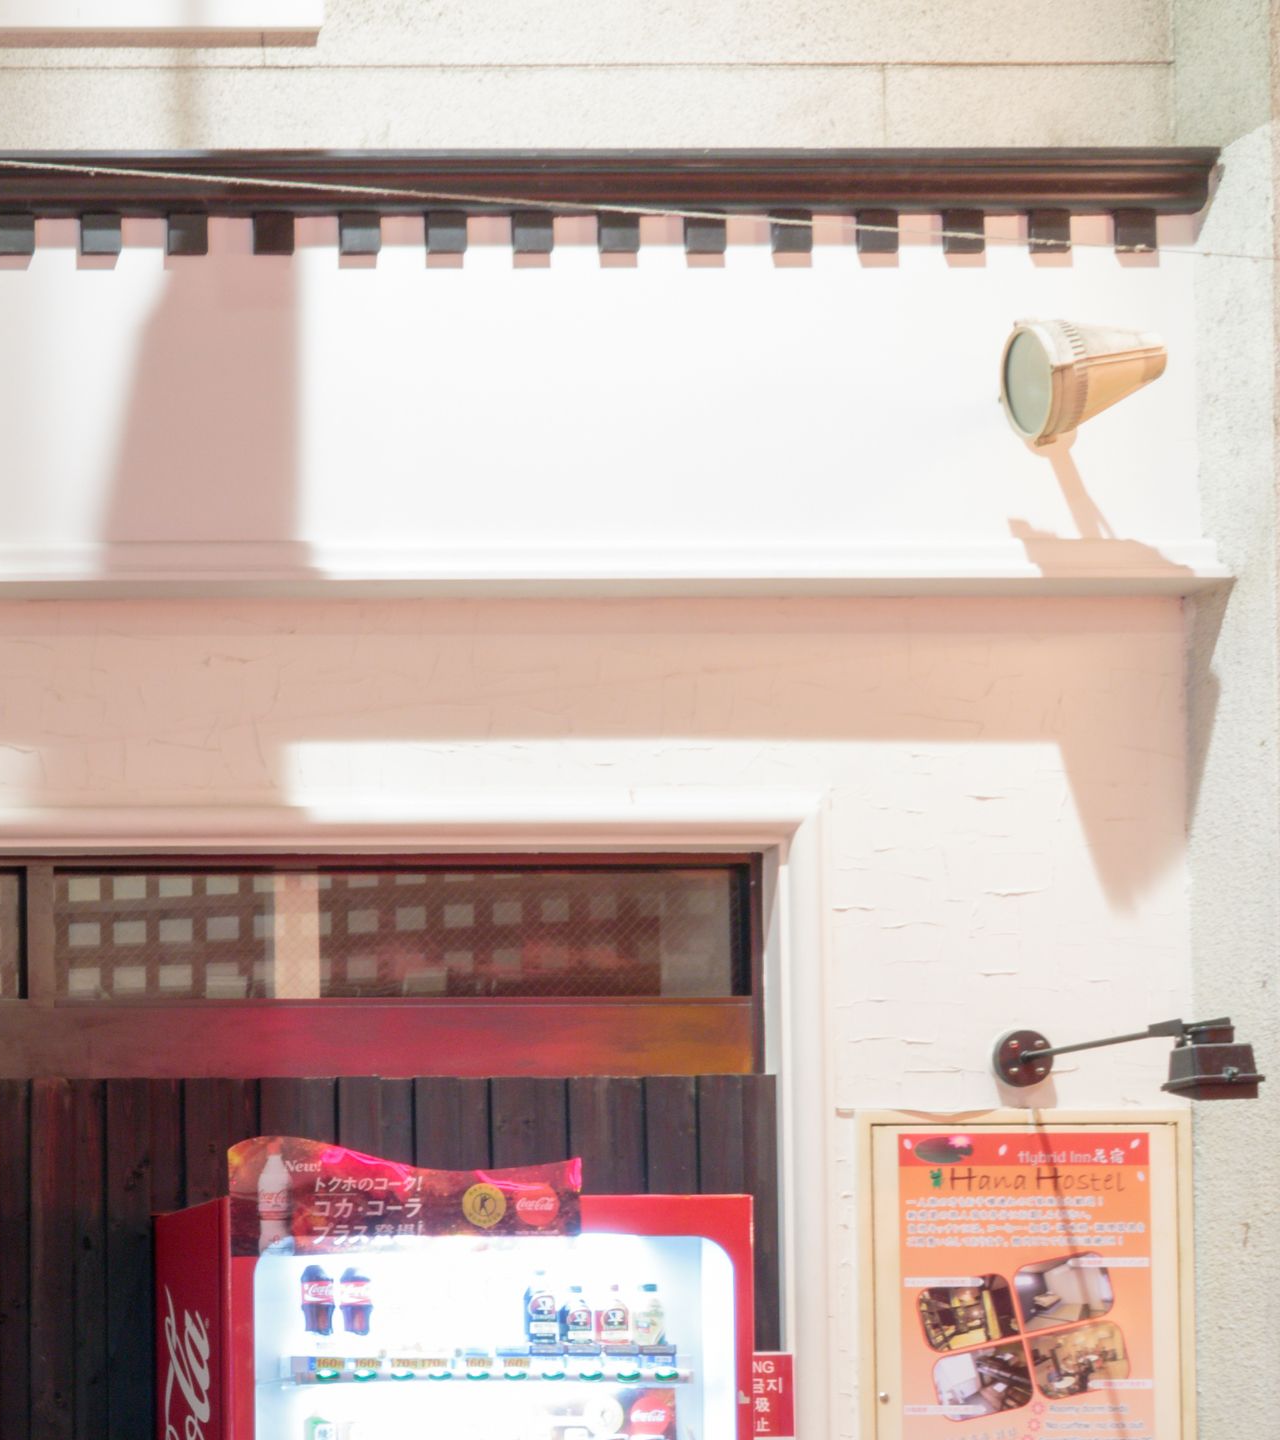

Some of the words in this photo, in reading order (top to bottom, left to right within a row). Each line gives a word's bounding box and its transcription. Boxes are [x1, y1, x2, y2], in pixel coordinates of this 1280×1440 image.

[283, 1160, 322, 1172] New!
[950, 1167, 1026, 1191] Hana
[1036, 1166, 1126, 1192] Hostel
